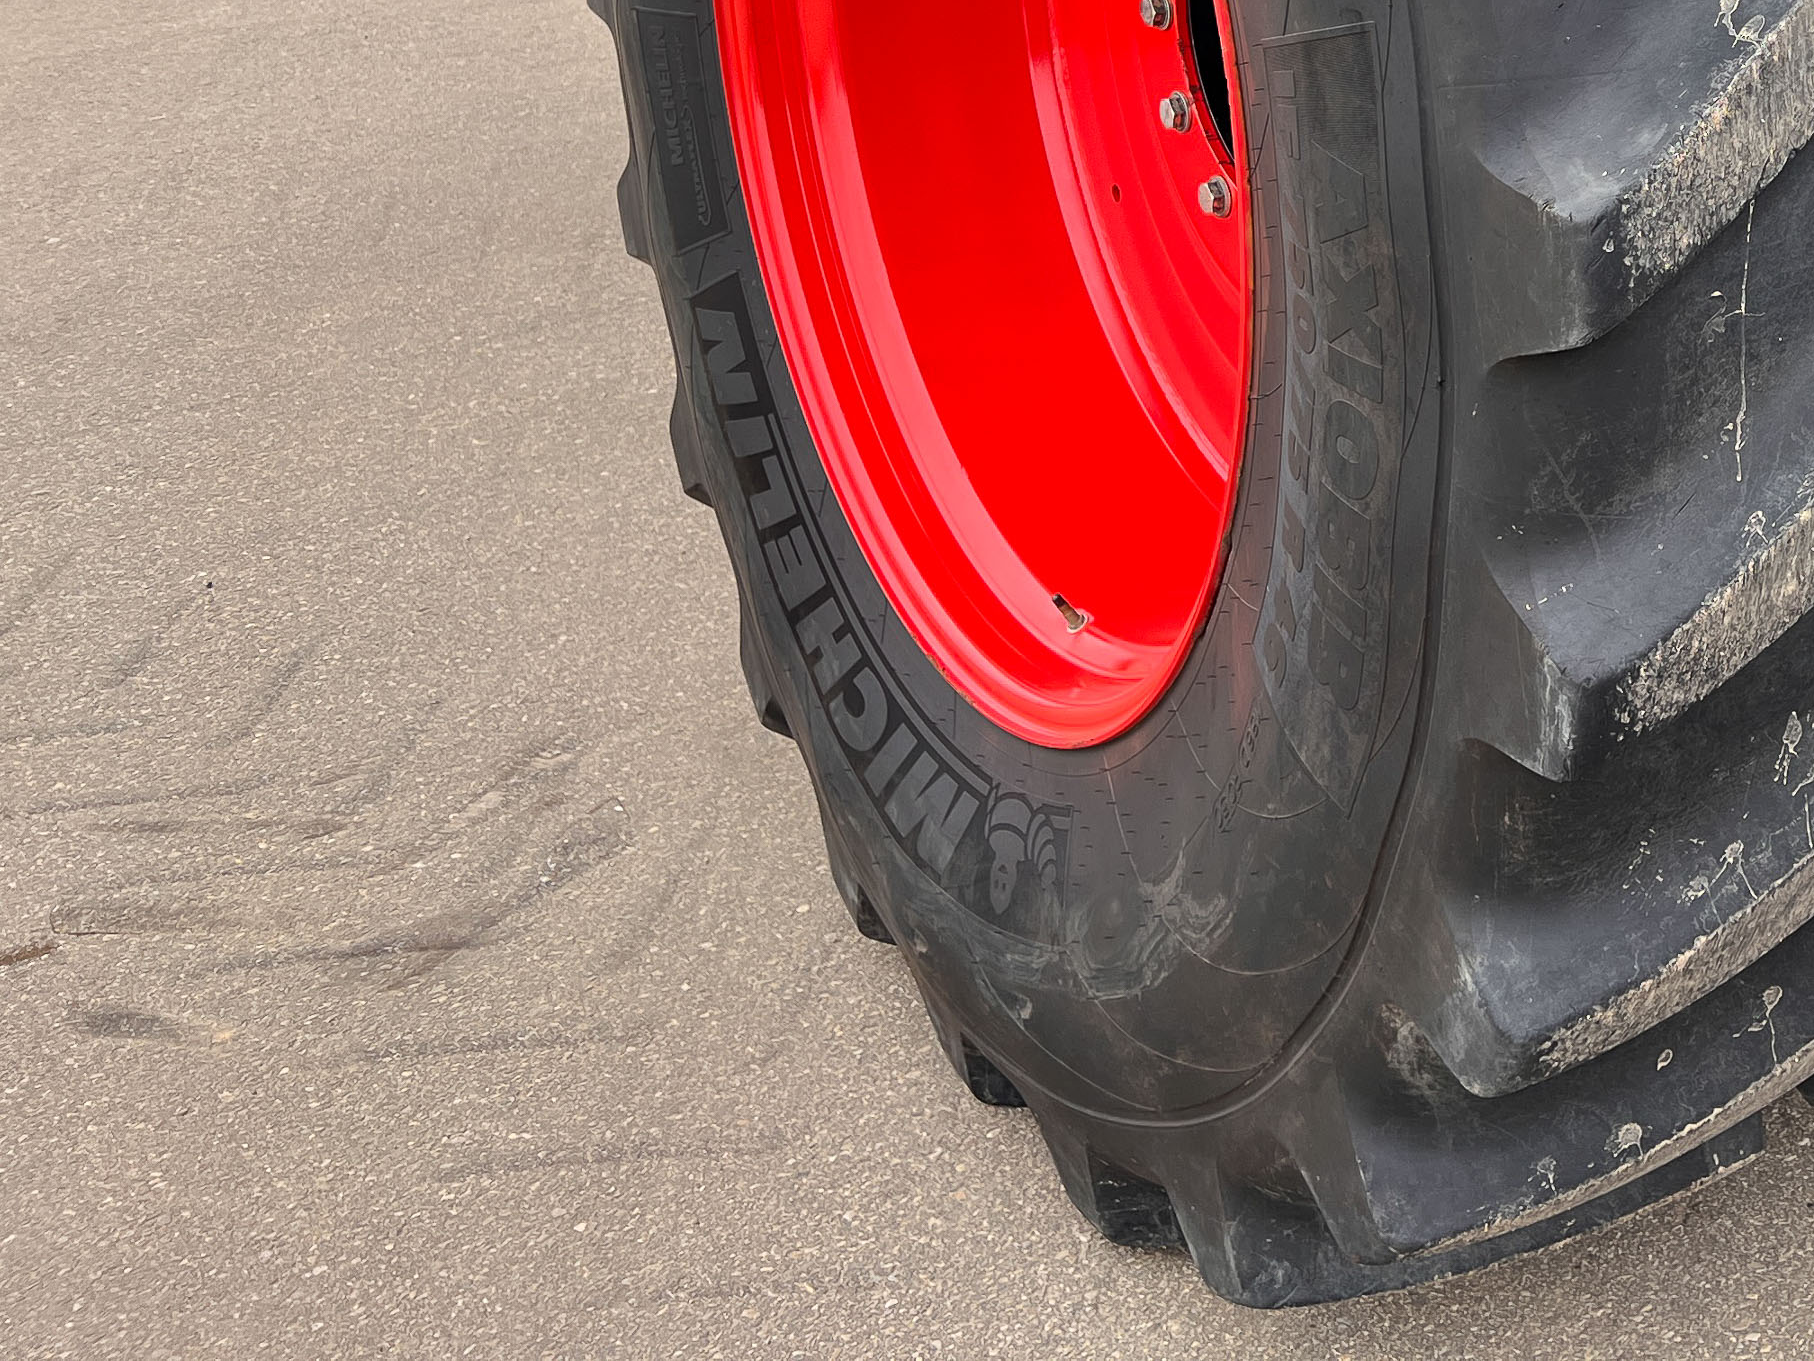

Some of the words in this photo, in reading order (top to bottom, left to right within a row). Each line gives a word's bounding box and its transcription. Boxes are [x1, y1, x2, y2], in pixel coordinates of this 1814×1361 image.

[649, 25, 684, 167] MICHELIN
[695, 307, 982, 883] MICHELIN
[1306, 139, 1384, 711] AXIOBIB
